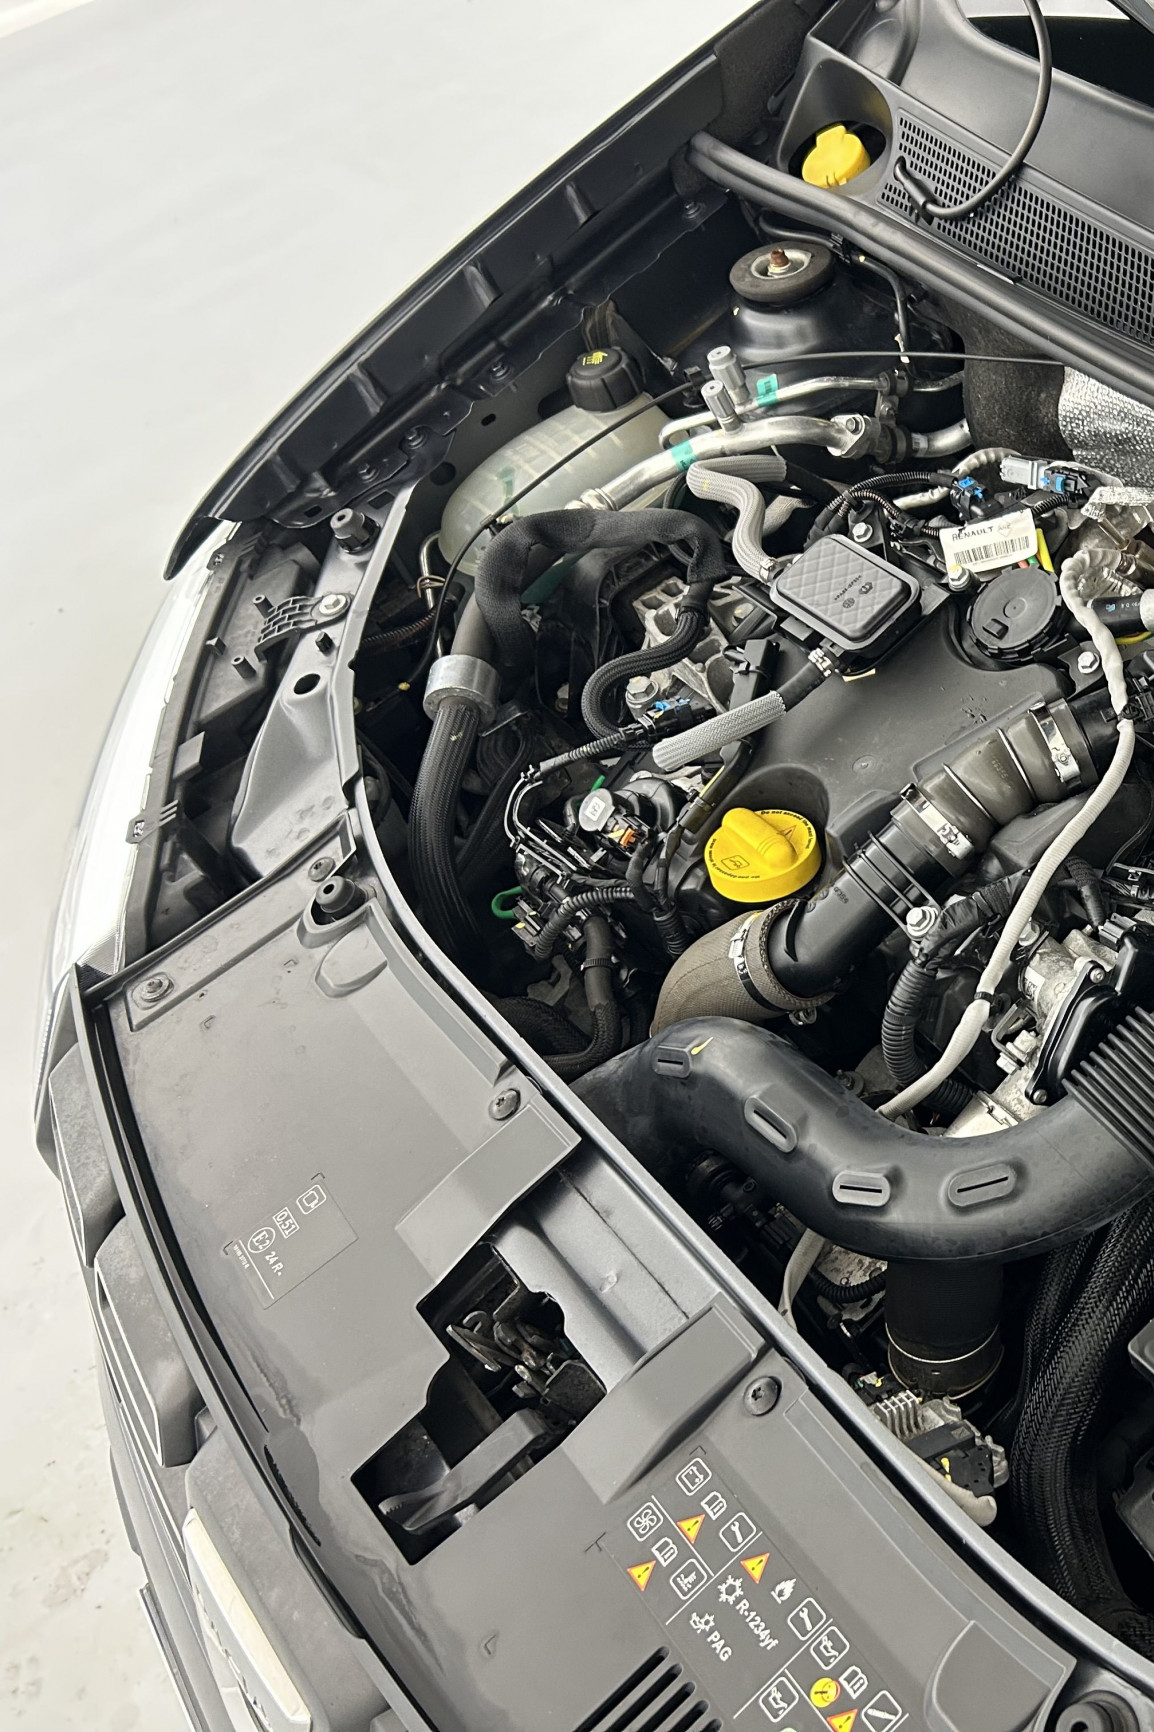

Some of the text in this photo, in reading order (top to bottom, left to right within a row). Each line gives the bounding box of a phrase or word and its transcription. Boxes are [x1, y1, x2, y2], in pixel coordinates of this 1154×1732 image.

[276, 1210, 295, 1235] 0,51
[252, 1230, 270, 1250] E2
[265, 1250, 278, 1265] 24
[735, 1599, 779, 1650] R-1234yf
[706, 1631, 732, 1661] PAG
